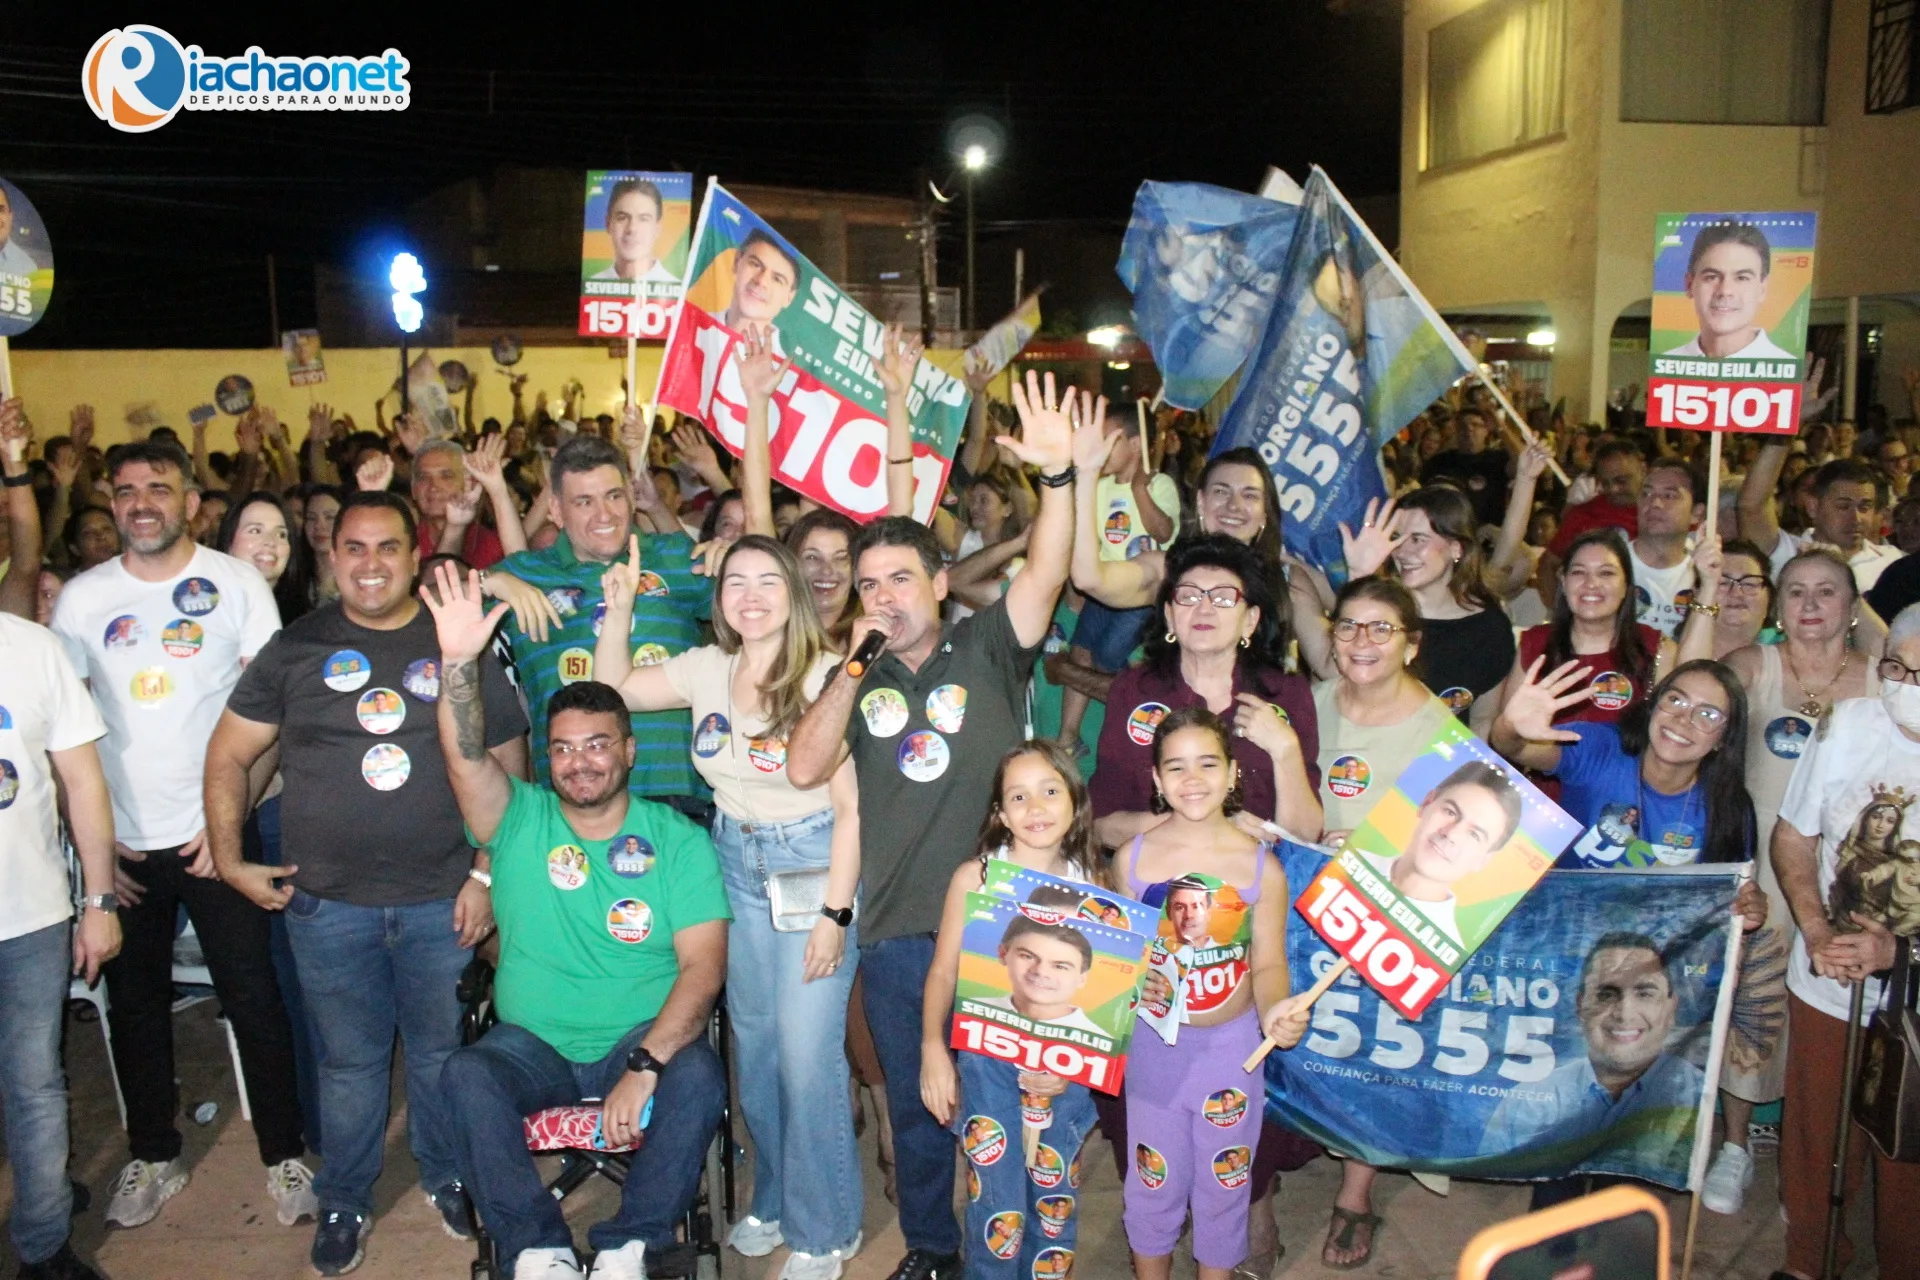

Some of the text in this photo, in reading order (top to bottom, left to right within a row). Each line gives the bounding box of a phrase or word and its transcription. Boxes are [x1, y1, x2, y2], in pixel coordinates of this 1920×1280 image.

[585, 281, 629, 295] SEVERO
[803, 277, 966, 407] SEVRO
[795, 346, 873, 400] DEPUTADO
[1655, 359, 1720, 377] SEVERO
[1258, 333, 1340, 466] ORGIANO
[1653, 383, 1794, 429] 15101
[695, 325, 944, 529] 15101
[565, 657, 587, 676] 151
[616, 862, 645, 873] 5555
[1001, 868, 1070, 894] DEPUTADO
[1338, 849, 1396, 908] SEVERO
[1307, 874, 1440, 1010] 15101
[1469, 954, 1559, 971] EDERAL
[1119, 962, 1135, 974] 13
[961, 1000, 1033, 1033] SEVERO
[1305, 989, 1556, 1083] 5555
[959, 1020, 1108, 1087] 15101
[1303, 1060, 1555, 1101] CONFIANÇA PARA FAZER ACONTECER
